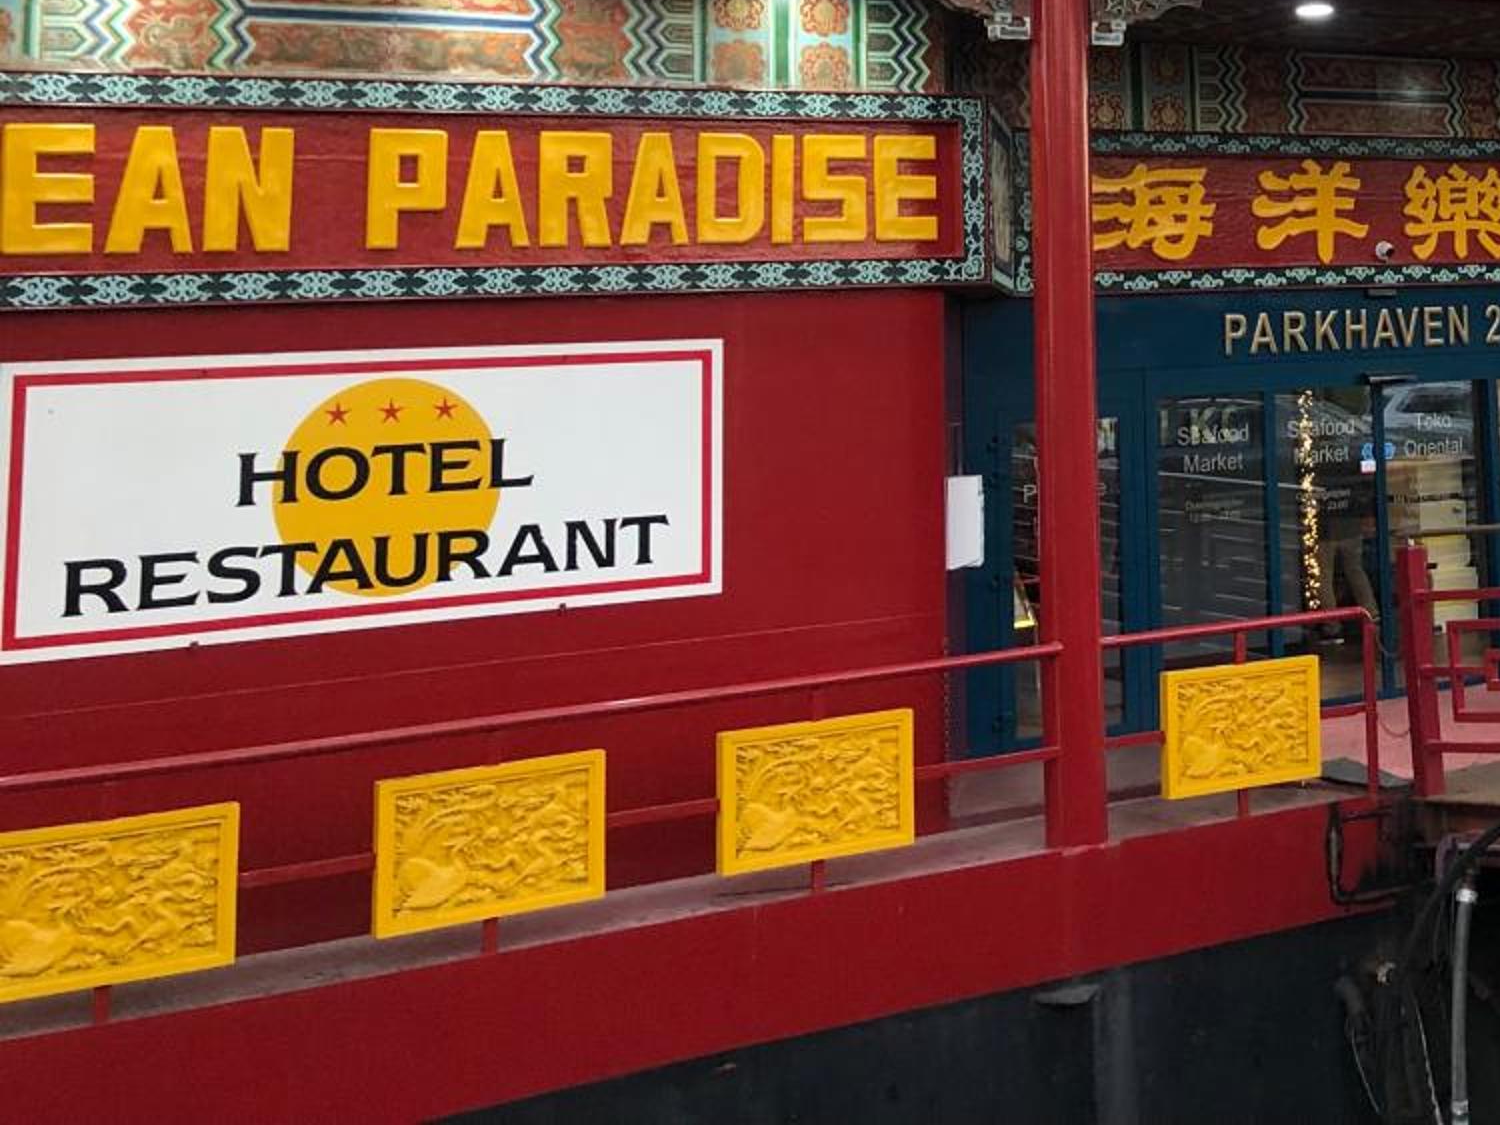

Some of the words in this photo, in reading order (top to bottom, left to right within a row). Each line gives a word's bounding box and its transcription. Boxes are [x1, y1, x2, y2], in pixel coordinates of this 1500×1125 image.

[365, 127, 939, 250] PARADISE
[1224, 304, 1470, 356] PARKHAVEN
[1286, 418, 1356, 439] Safood
[1415, 412, 1452, 431] Toko
[1183, 452, 1244, 474] Market
[1404, 437, 1463, 457] Oriental
[234, 437, 535, 508] HOTEL
[61, 513, 671, 618] RESTAURANT
